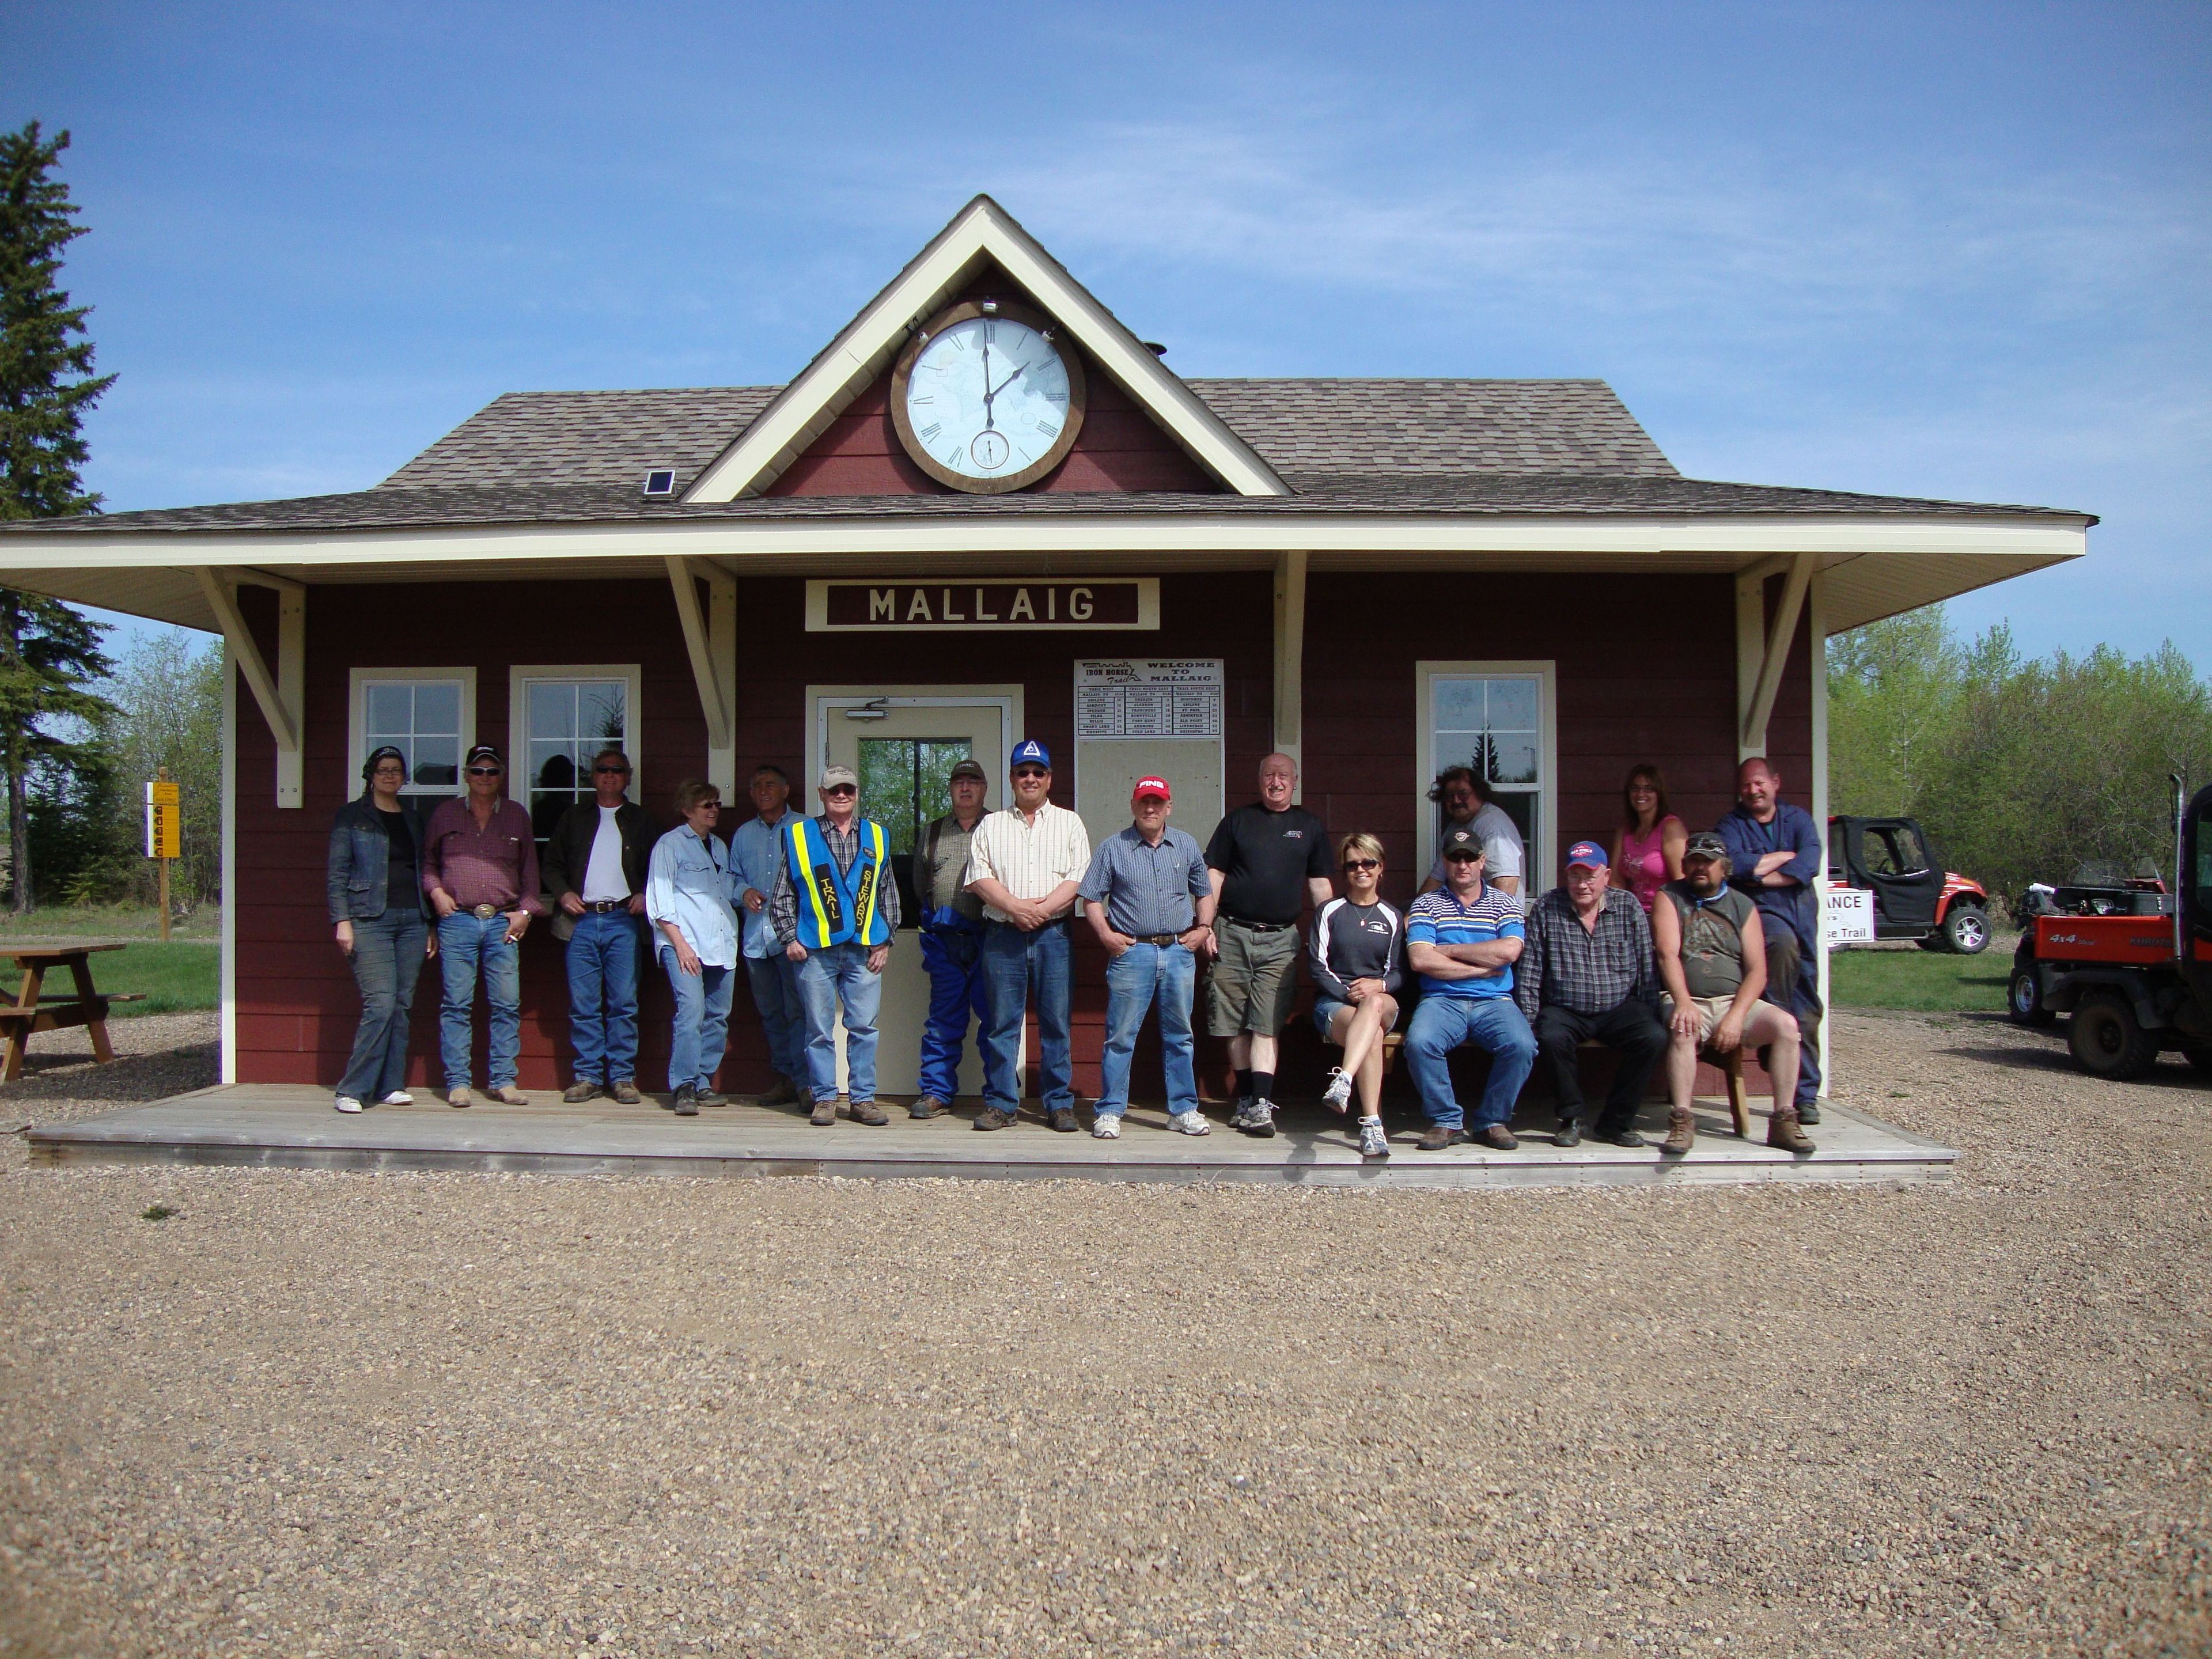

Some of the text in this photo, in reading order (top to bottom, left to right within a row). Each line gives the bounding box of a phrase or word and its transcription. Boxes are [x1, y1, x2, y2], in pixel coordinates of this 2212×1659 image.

[870, 588, 1093, 620] MALLAIG
[1107, 676, 1130, 684] Trail
[820, 878, 840, 919] TRAIL
[857, 870, 872, 926] STEWARD
[1840, 928, 1866, 937] Trail
[2050, 934, 2076, 943] 4x4
